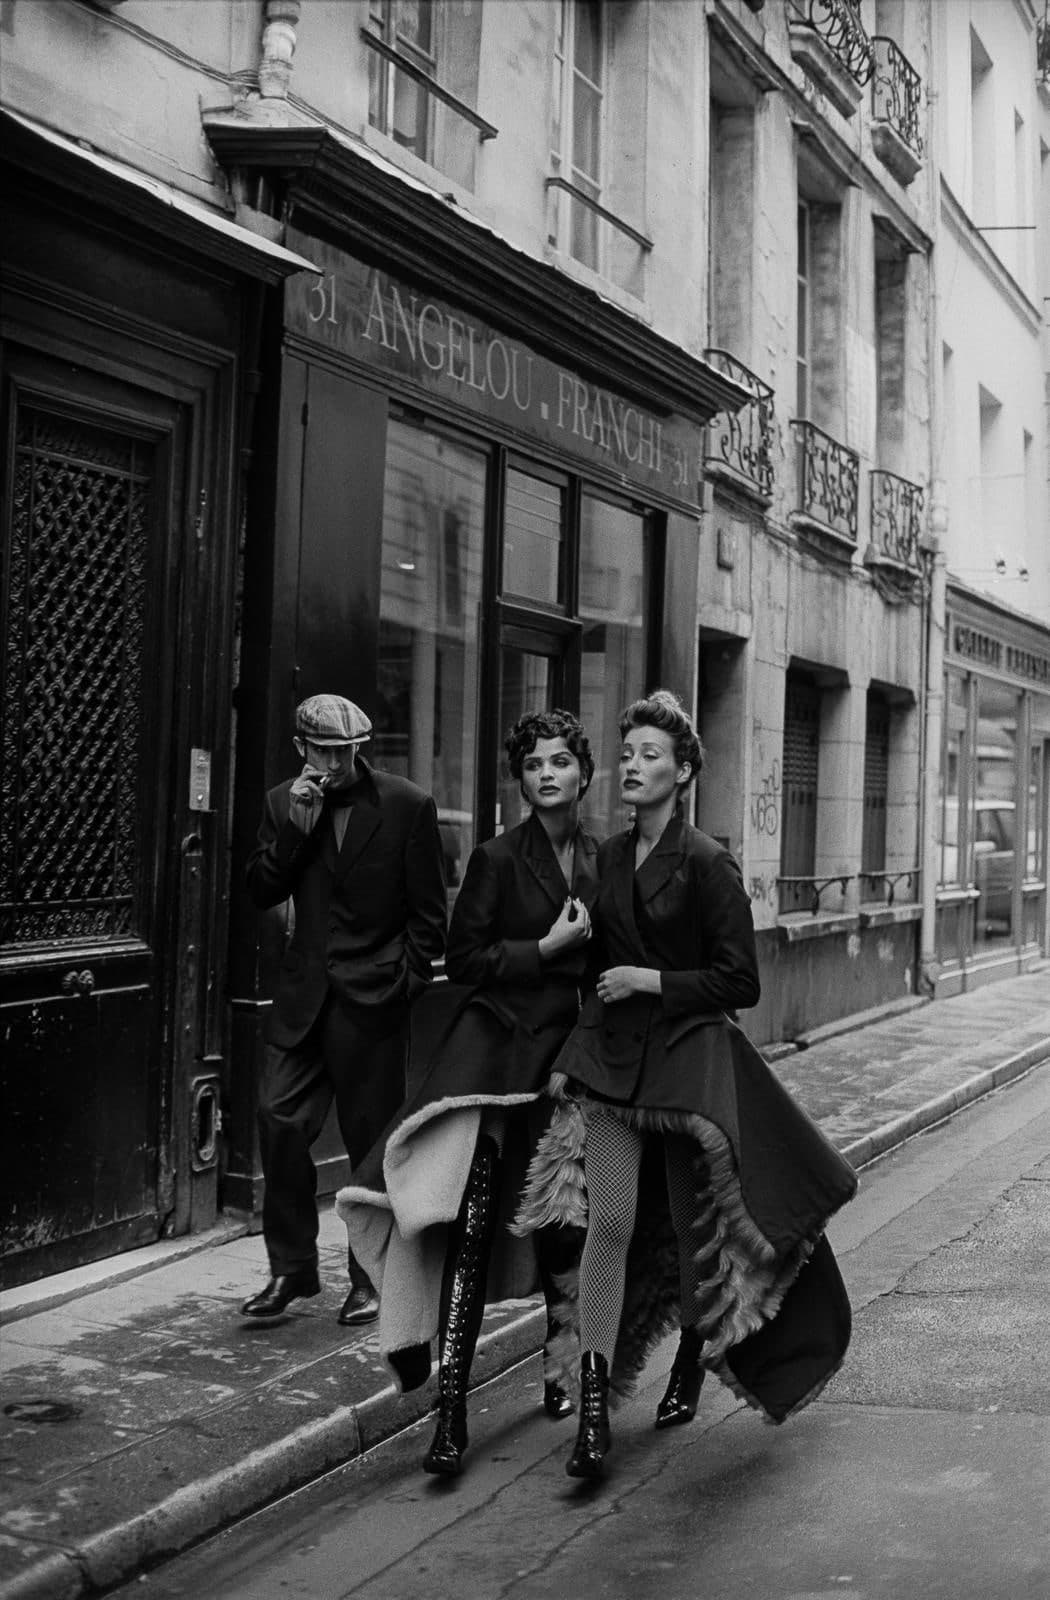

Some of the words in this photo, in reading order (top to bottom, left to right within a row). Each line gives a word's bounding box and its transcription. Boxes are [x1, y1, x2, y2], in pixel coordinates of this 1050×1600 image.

[308, 274, 338, 325] 31
[361, 270, 534, 411] ANGELOU
[556, 371, 663, 473] FRANCHI
[672, 447, 689, 486] 31
